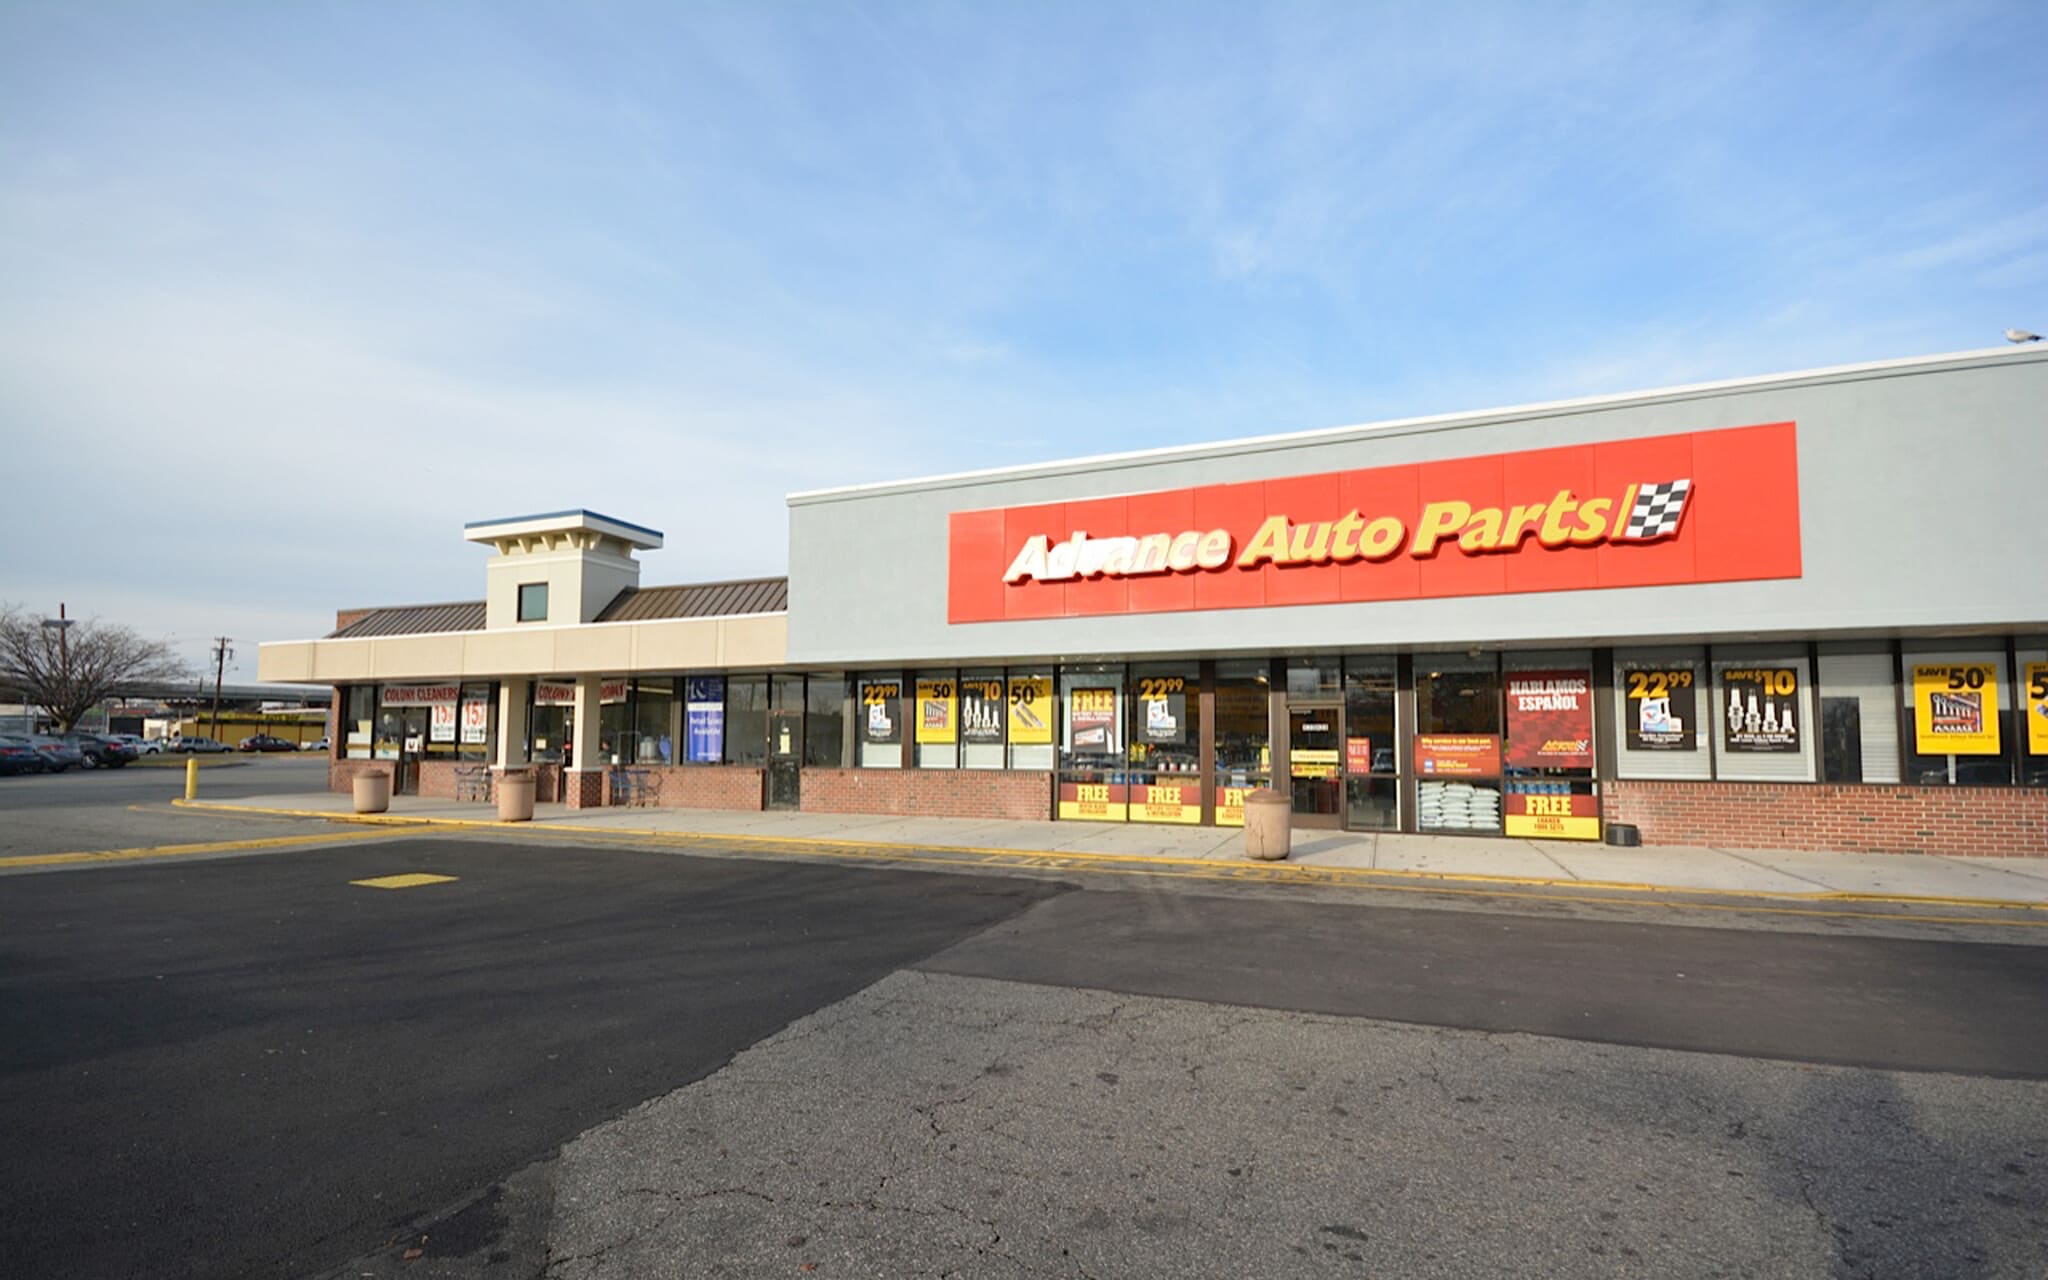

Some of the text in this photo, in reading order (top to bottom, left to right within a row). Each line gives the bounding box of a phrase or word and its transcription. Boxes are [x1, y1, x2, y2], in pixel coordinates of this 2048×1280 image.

[1001, 488, 1614, 585] Advance Auto Parts
[1725, 670, 1754, 681] SAVE
[1917, 667, 1947, 677] SAVE
[417, 686, 459, 702] CLEANERS
[1510, 679, 1588, 696] HABLAMOS
[1071, 689, 1114, 713] FREE
[1518, 692, 1579, 712] ESPAÑOL
[1076, 783, 1110, 803] FREE
[1147, 785, 1182, 805] FREE
[1223, 787, 1250, 807] FR
[1525, 795, 1572, 816] FREE
